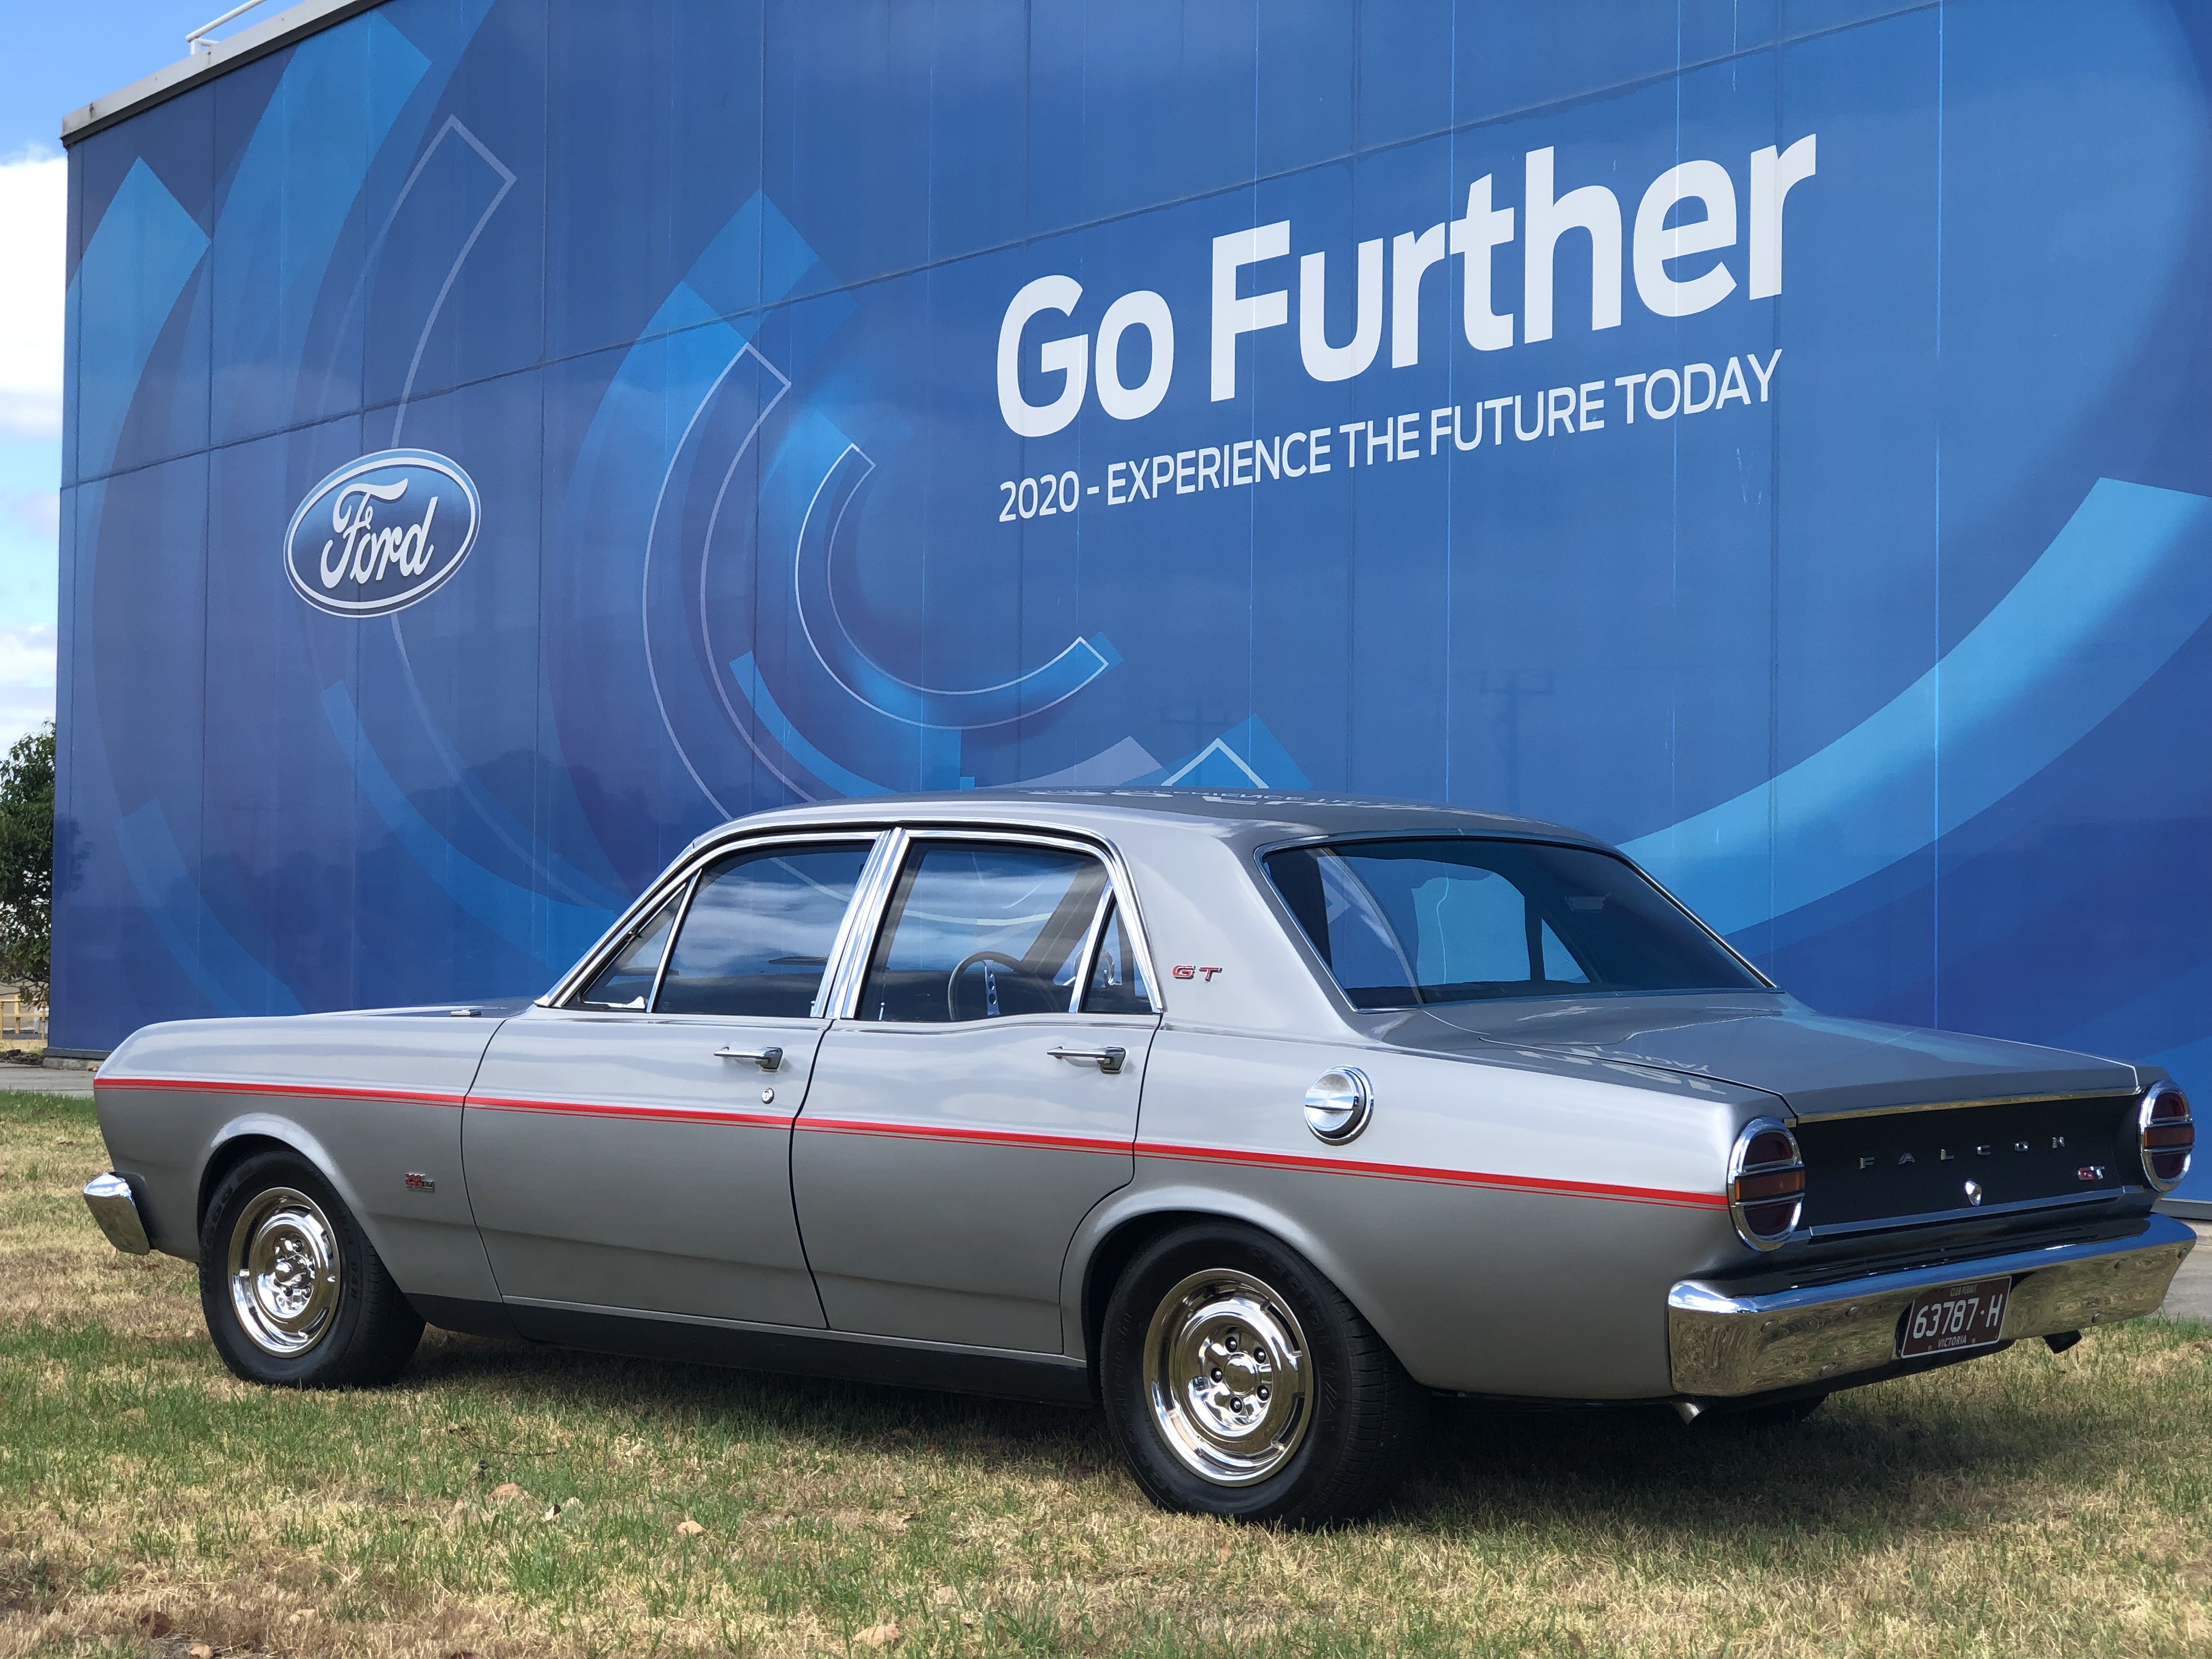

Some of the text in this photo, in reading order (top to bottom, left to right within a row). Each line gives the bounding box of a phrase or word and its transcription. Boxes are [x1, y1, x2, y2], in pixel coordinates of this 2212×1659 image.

[997, 134, 1816, 437] Go Further
[1000, 471, 1079, 522] 2020
[1108, 428, 1330, 505] EXPERIENCE
[1340, 413, 1419, 467] THE
[1431, 381, 1604, 455] FUTURE
[1615, 349, 1782, 424] TODAY
[321, 478, 438, 588] Ford
[1172, 965, 1223, 982] GT
[1859, 1136, 2065, 1170] FALCON
[2078, 1166, 2105, 1181] GT
[1938, 1335, 1967, 1348] VICTORIA
